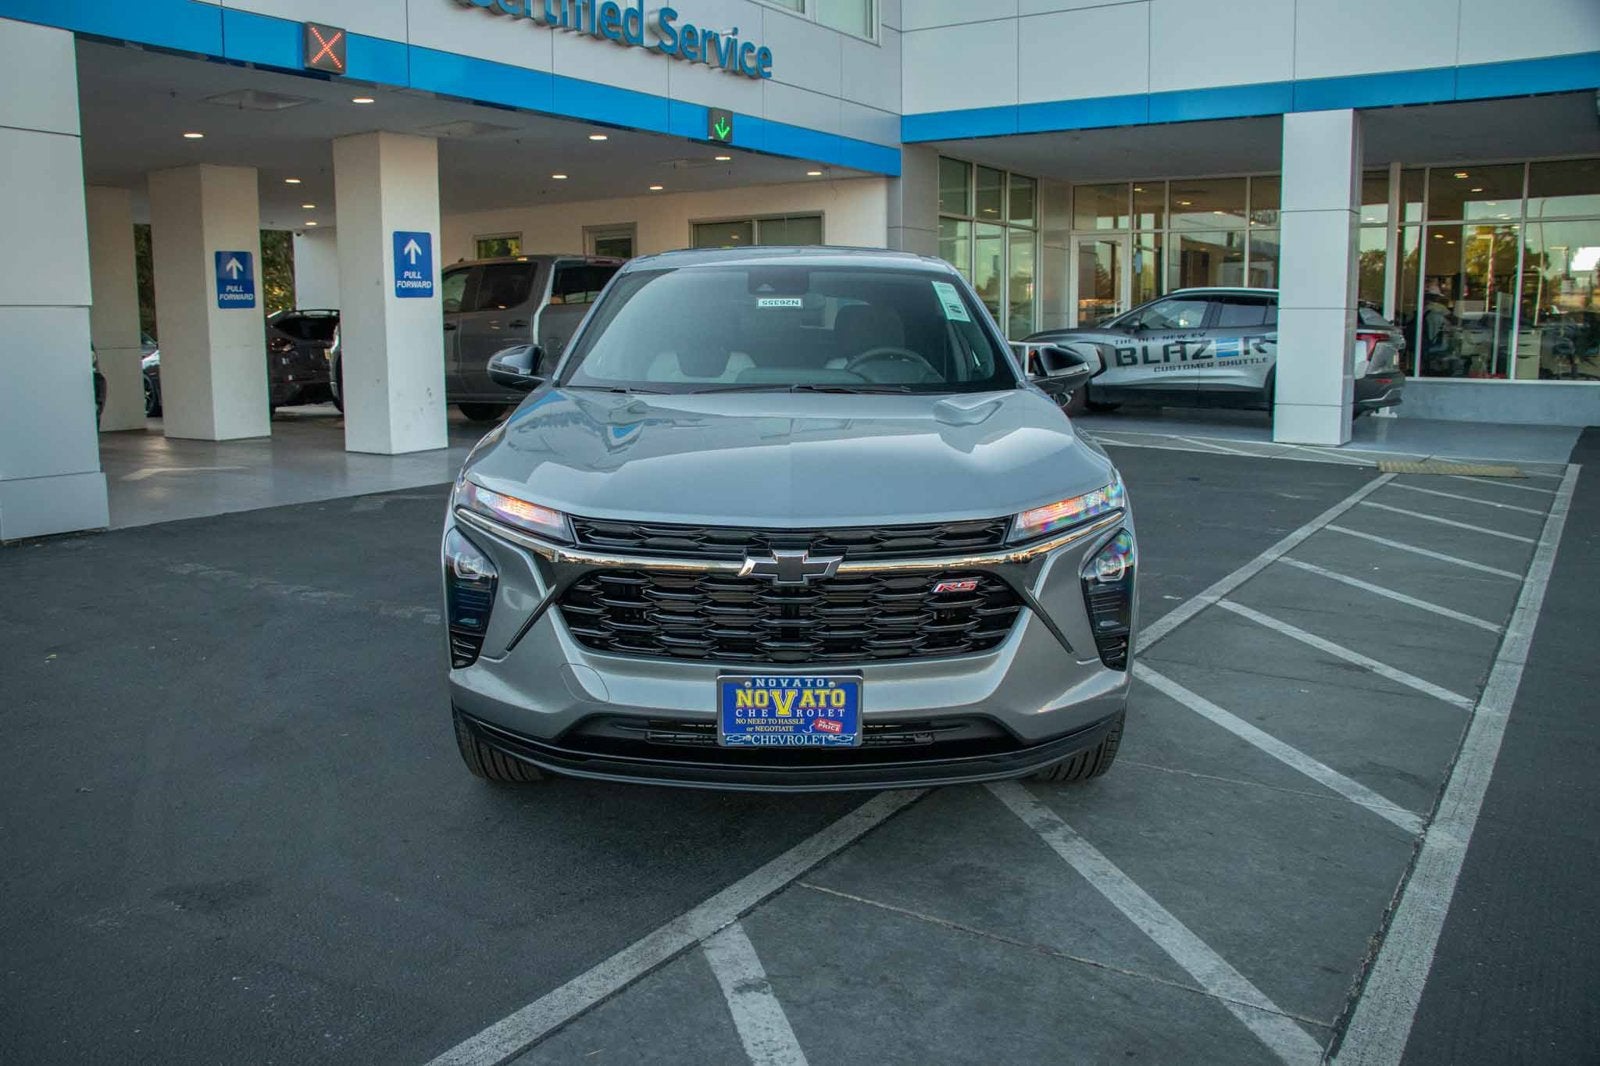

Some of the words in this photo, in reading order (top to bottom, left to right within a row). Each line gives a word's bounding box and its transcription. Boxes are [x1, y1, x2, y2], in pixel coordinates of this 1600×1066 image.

[469, 0, 644, 45] tified
[658, 7, 772, 79] Service
[403, 271, 422, 279] PULL
[397, 281, 432, 289] FORWARD
[1115, 335, 1268, 367] BLAZER
[1154, 362, 1214, 373] CUSTOMER
[1218, 357, 1268, 368] SHUTTLE
[932, 580, 978, 593] RS
[756, 679, 825, 687] NOVATO
[735, 688, 846, 717] NOVATO
[751, 735, 828, 745] CHEVROLET
